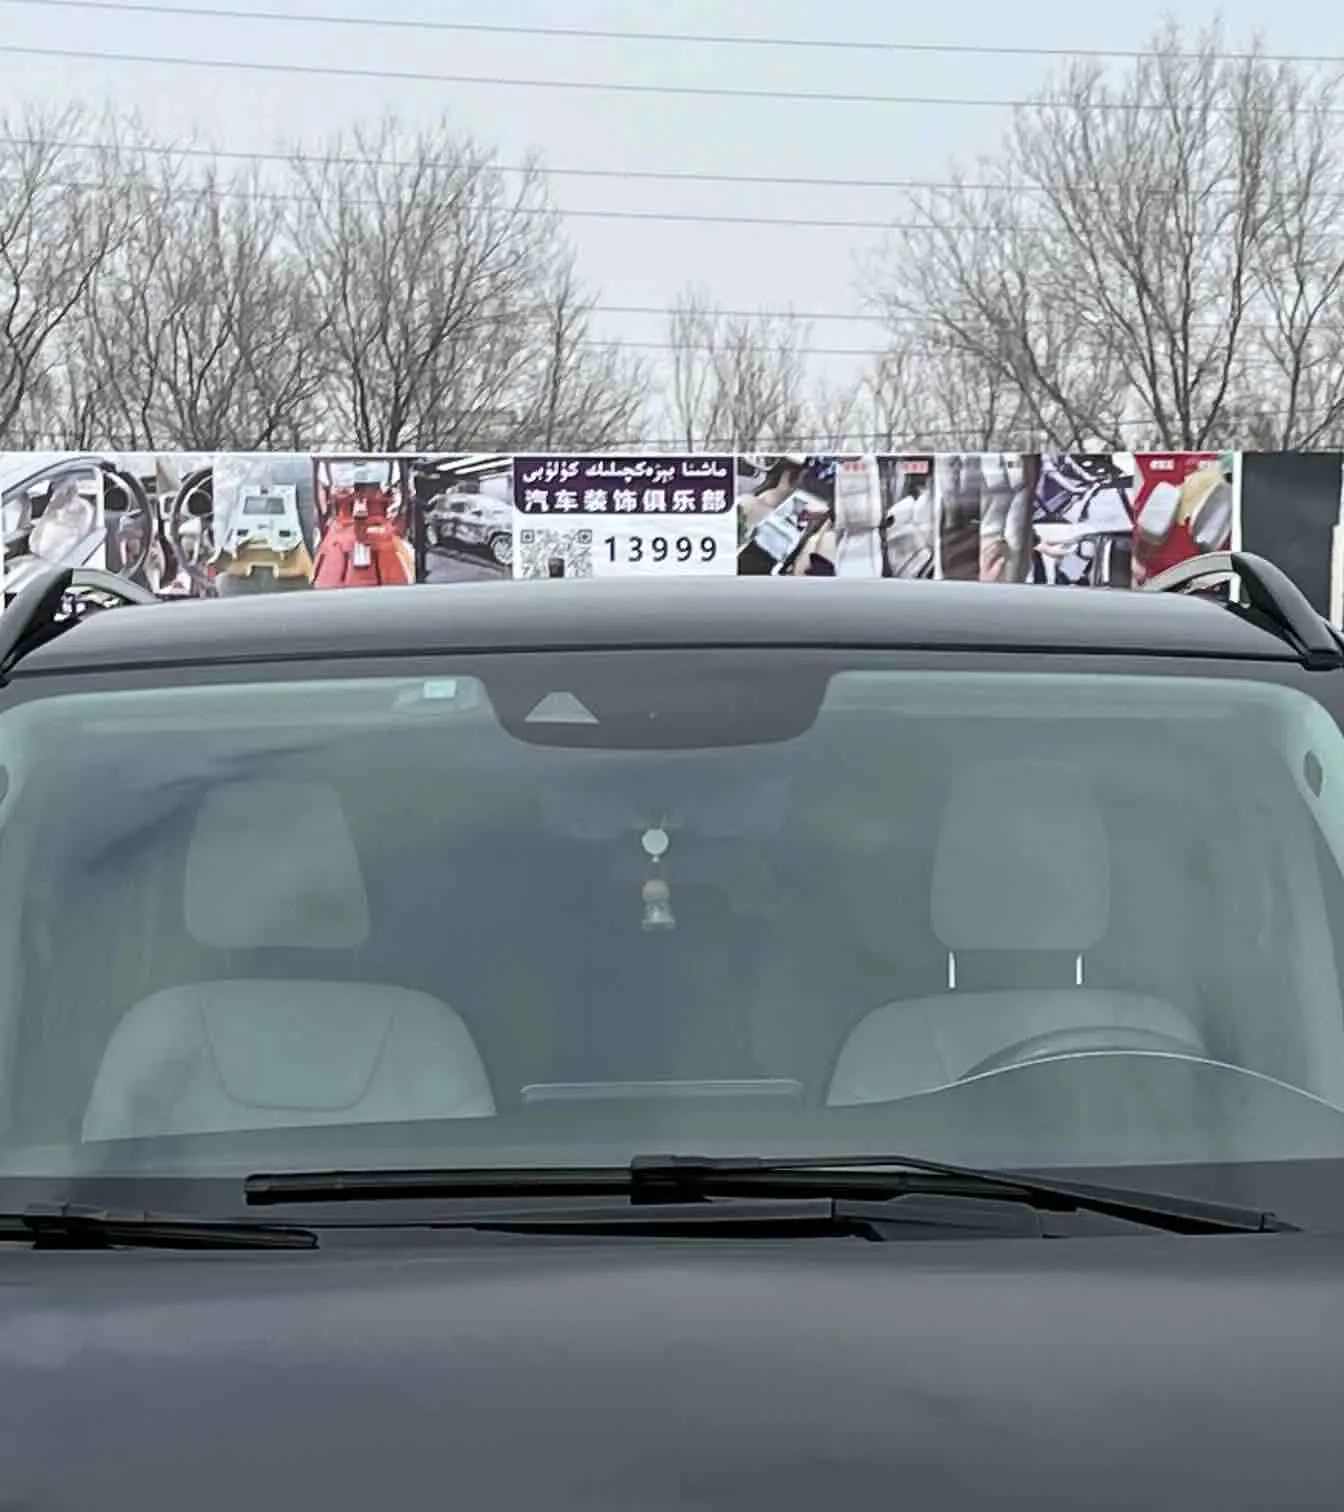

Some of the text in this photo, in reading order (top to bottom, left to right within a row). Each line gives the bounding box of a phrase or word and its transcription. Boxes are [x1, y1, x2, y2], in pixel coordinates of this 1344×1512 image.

[524, 488, 727, 513] 汽车装饰俱乐部
[604, 535, 717, 562] 13999
